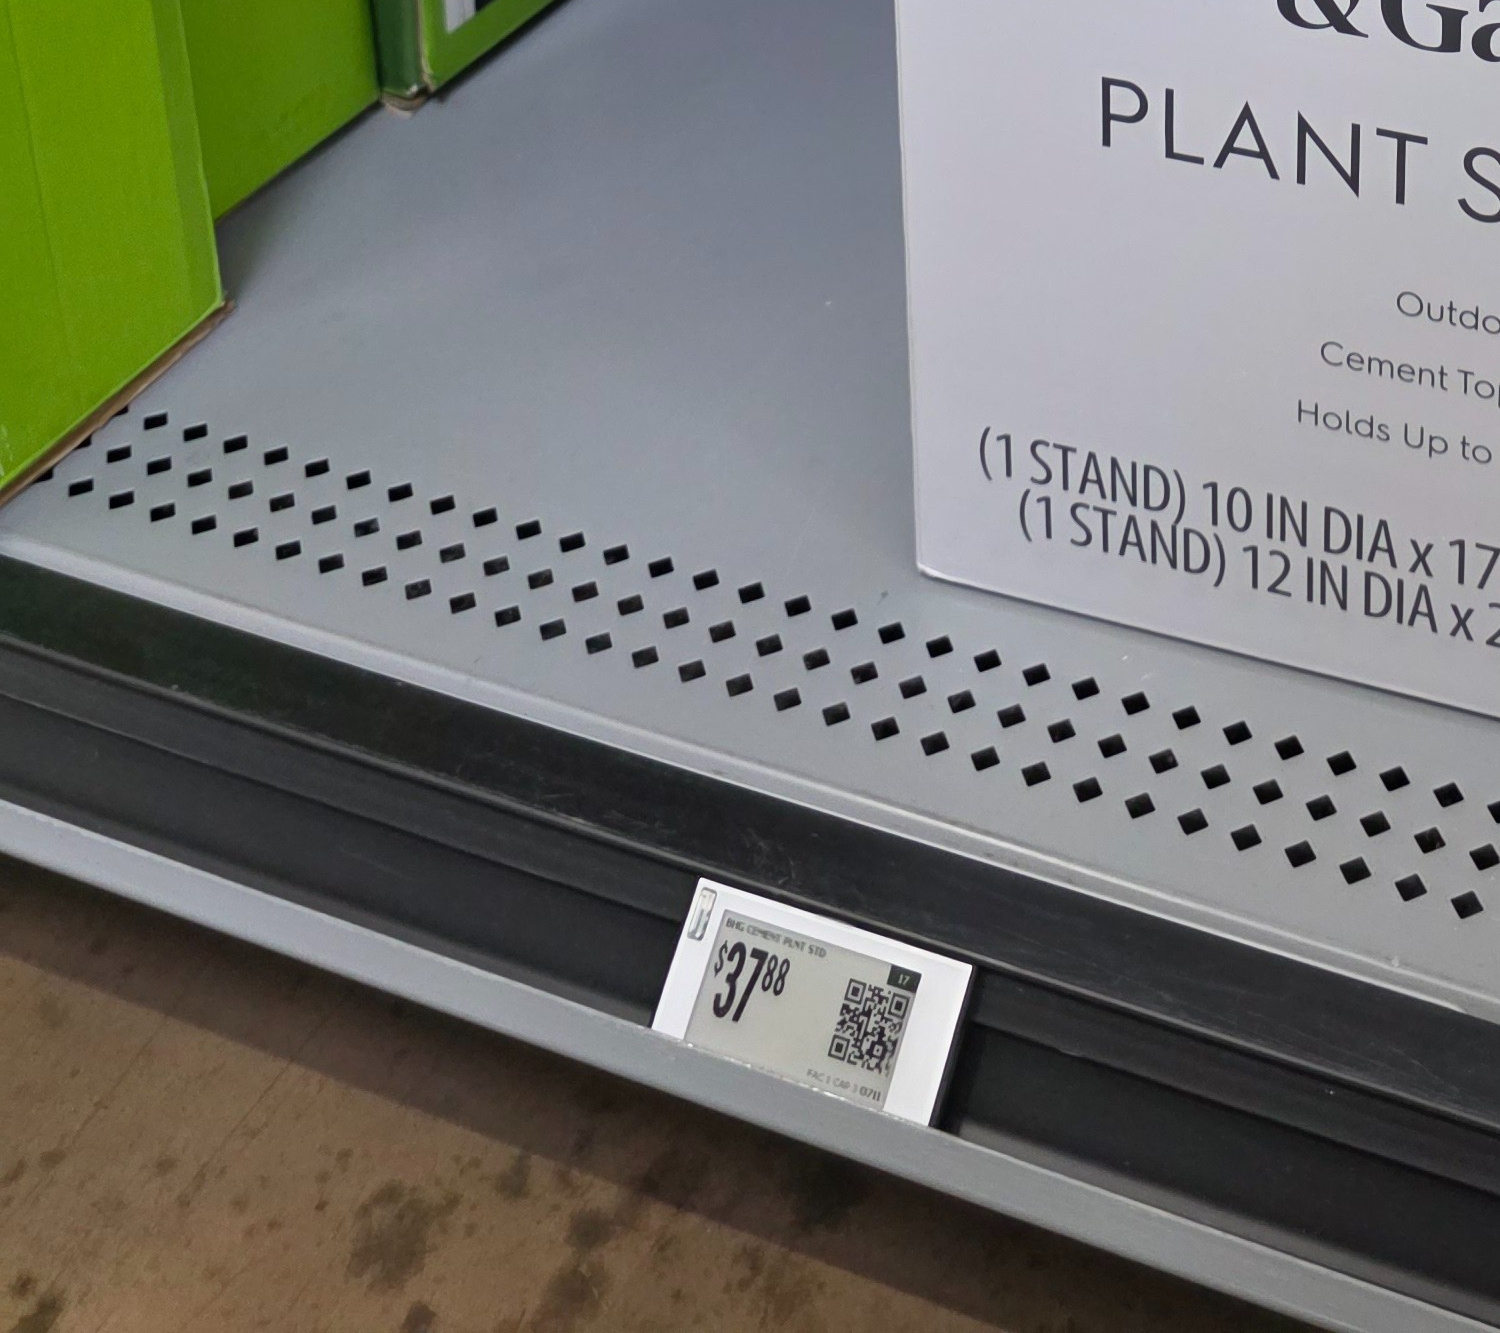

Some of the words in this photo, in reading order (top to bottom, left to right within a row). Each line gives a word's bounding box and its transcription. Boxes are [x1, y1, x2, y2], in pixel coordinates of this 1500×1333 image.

[1101, 76, 1428, 205] PLANT
[1319, 340, 1449, 392] Cement
[1296, 398, 1391, 443] Holds
[1403, 423, 1449, 460] Up
[1460, 438, 1493, 465] to
[979, 426, 1014, 480] (1
[1029, 439, 1187, 527] STAND)
[1202, 481, 1254, 533] 10
[1265, 492, 1309, 548] IN
[1323, 506, 1398, 570] DIA
[1408, 539, 1435, 578] x
[1018, 489, 1054, 542] (1
[1069, 502, 1227, 587] STAND)
[1242, 545, 1293, 599] 12
[1305, 556, 1349, 612] IN
[1363, 570, 1439, 635] DIA
[1448, 602, 1475, 643] x
